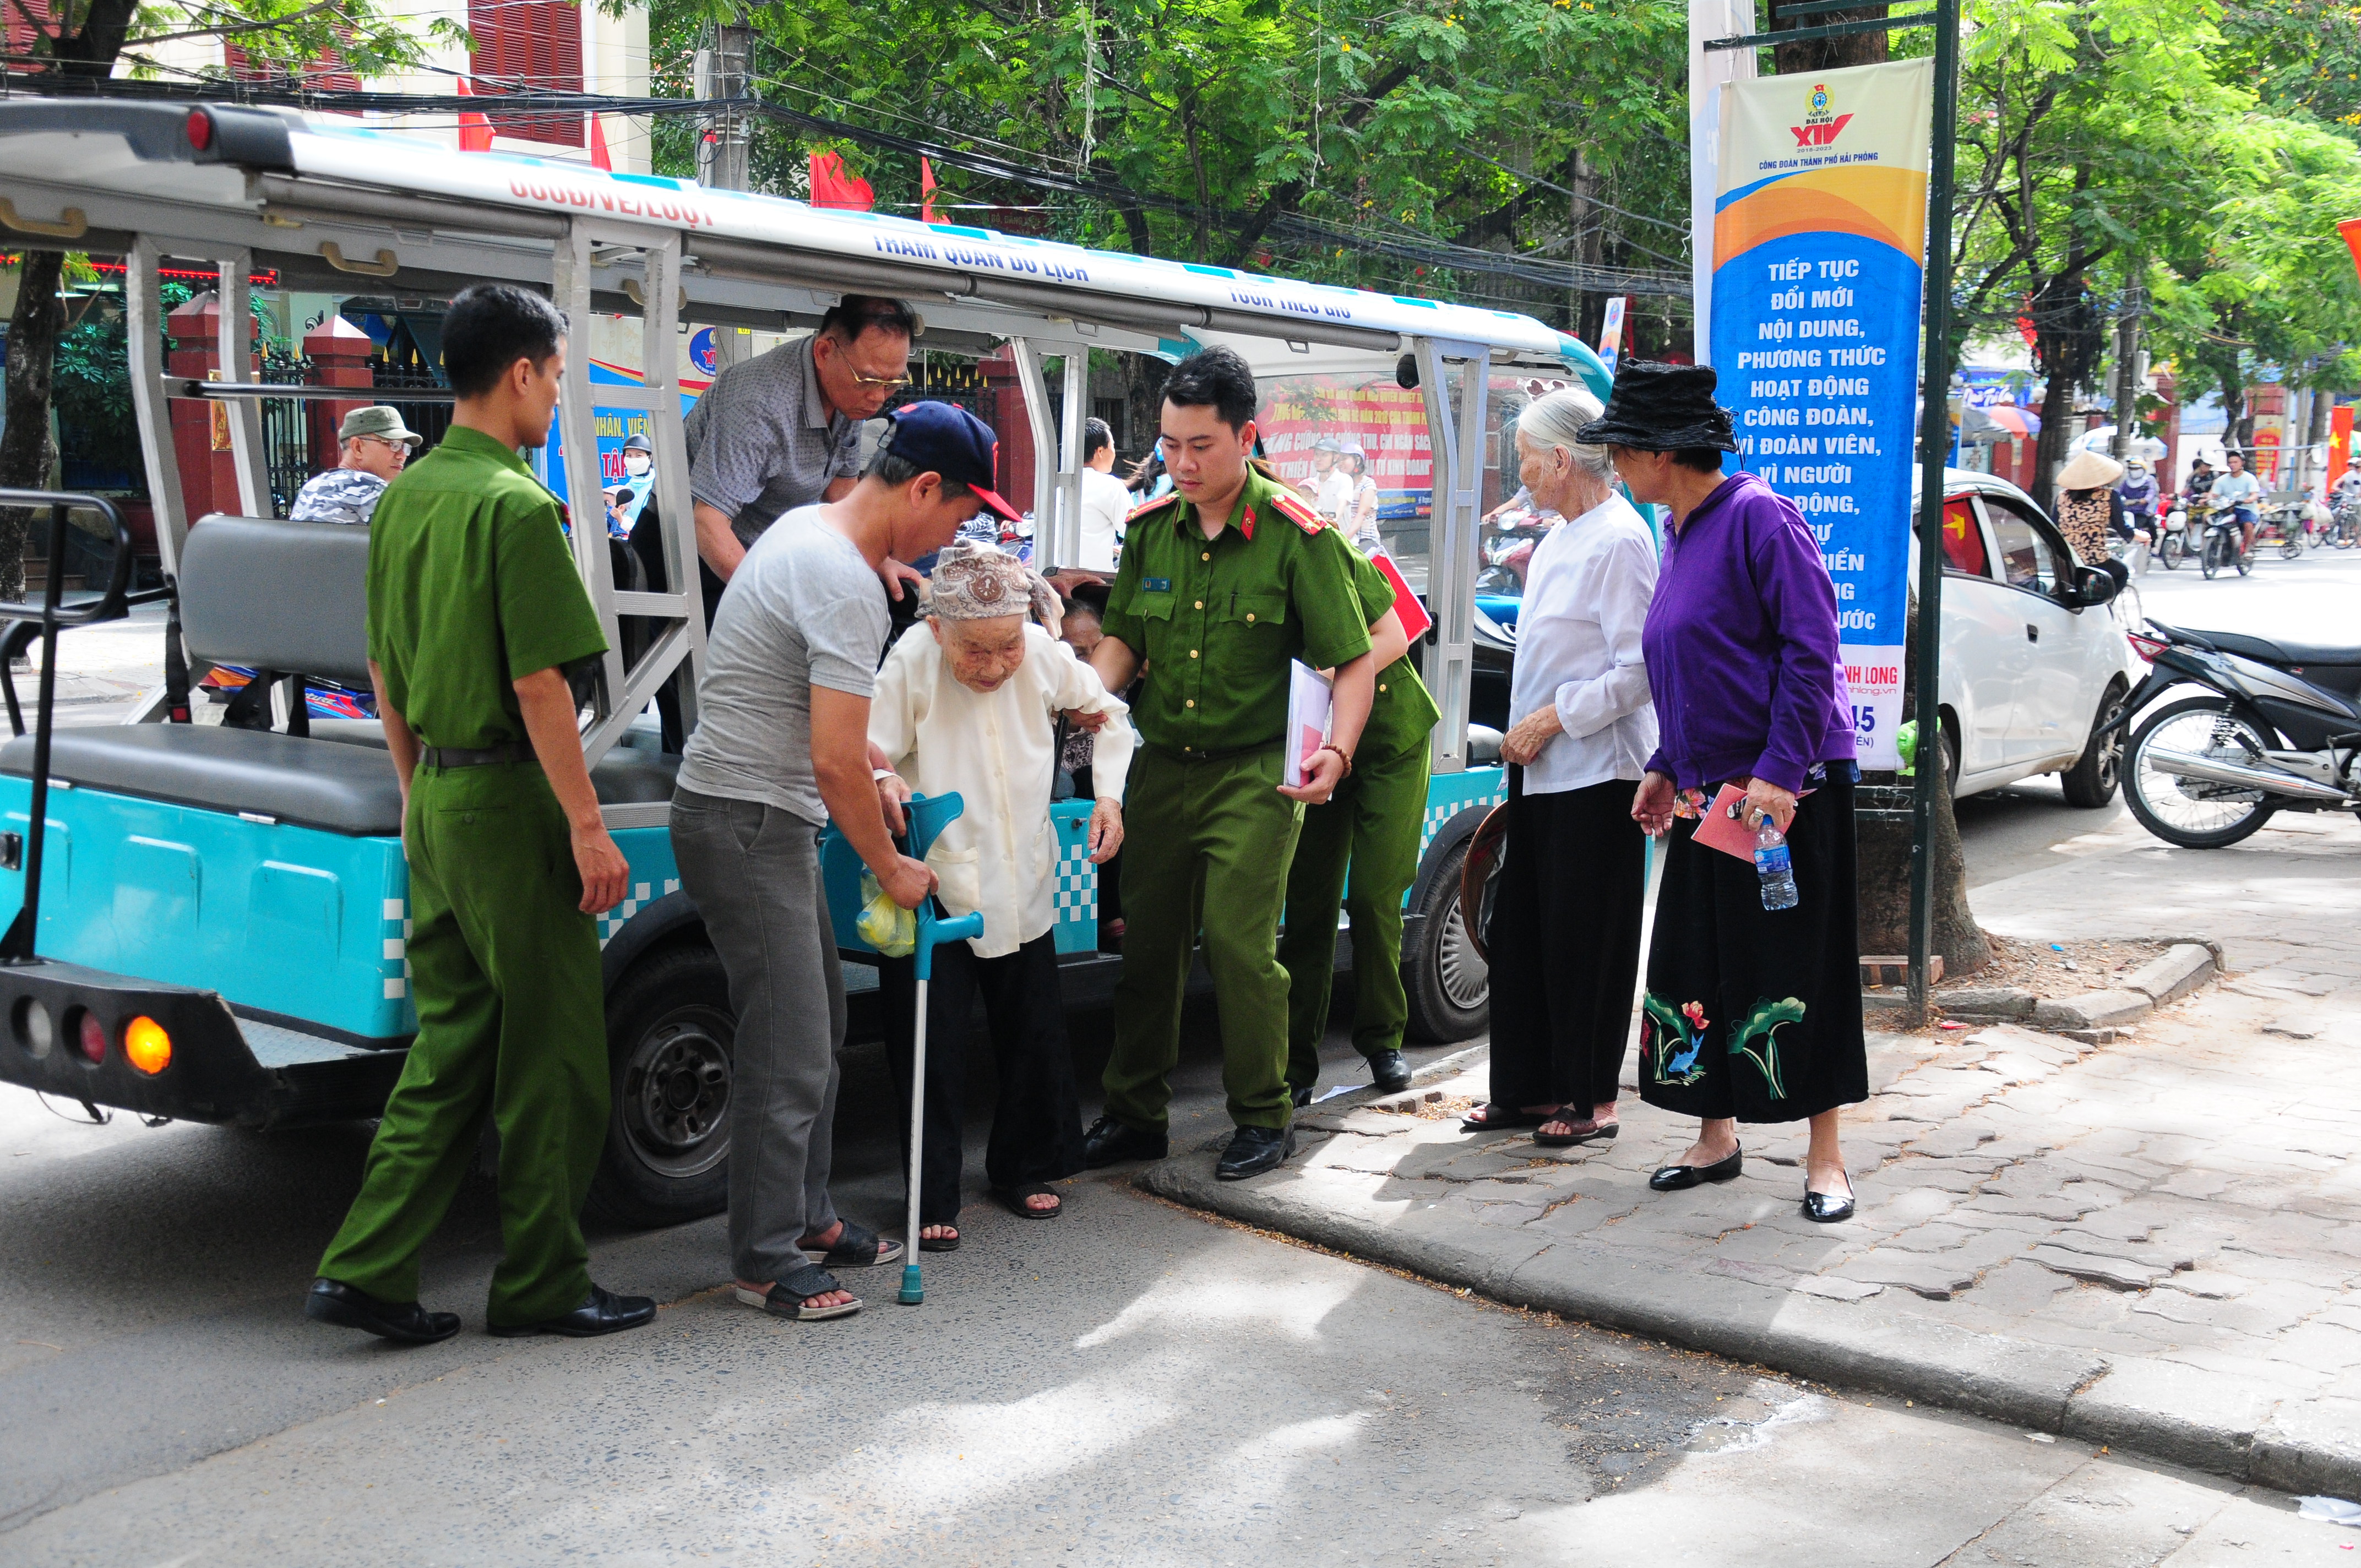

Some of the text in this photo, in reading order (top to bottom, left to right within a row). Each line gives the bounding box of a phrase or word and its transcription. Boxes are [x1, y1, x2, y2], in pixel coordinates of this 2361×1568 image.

[1790, 113, 1855, 147] XIV
[1759, 151, 1879, 170] CÔNG ĐOÀN THÀNH PHỐ HẢI PHÒNG
[873, 235, 1090, 282] THAM QUAN DU LỊCH
[1769, 257, 1859, 281] TIẾP TỤC
[1771, 285, 1853, 310] ĐỔI MỚI
[1759, 319, 1865, 342] NỘI DUNG,
[1738, 345, 1886, 369] PHƯƠNG THỨC
[1750, 375, 1869, 401] HOẠT ĐỘNG
[594, 412, 625, 440] NHÂN,
[1744, 403, 1874, 428] CÔNG ĐOÀN,
[1760, 434, 1818, 455] ĐOÀN
[1825, 434, 1881, 456] VIÊN,
[1760, 462, 1852, 484] VÌ NGƯỜI
[1794, 492, 1860, 516] ĐỘNG,
[1837, 609, 1876, 630] ƯỚC
[1845, 665, 1898, 684] NH LONG
[1847, 686, 1897, 696] nhlong.vn
